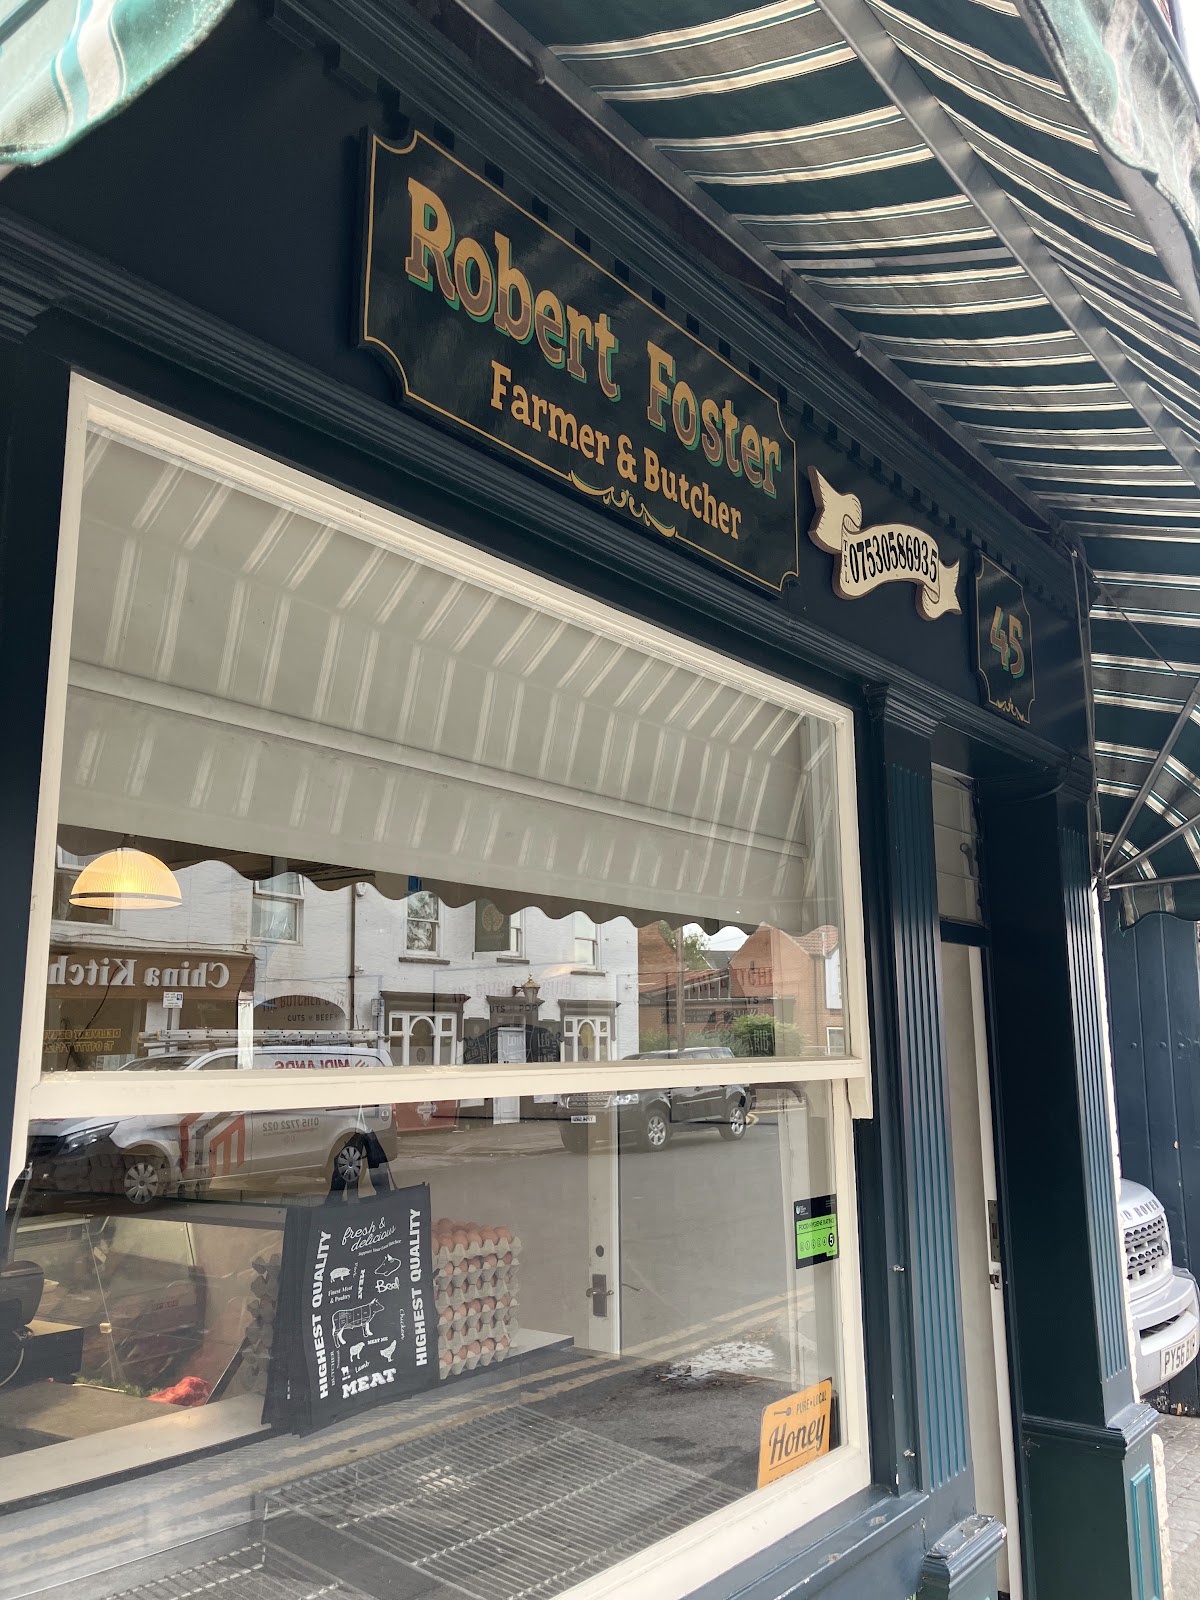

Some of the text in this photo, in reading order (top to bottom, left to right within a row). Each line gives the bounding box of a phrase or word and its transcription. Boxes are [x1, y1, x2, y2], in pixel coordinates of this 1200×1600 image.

[404, 177, 782, 499] Robert Foster
[490, 360, 742, 540] Farmer & Butcher
[850, 531, 939, 584] 07530586935
[989, 605, 1026, 679] 45
[287, 1014, 305, 1022] CUTS
[316, 1013, 334, 1021] BEEF
[490, 1004, 506, 1013] UTS
[518, 1003, 538, 1013] POR
[1133, 1199, 1160, 1217] ROVER
[341, 1217, 386, 1246] fresh &
[351, 1225, 397, 1252] delicious
[375, 1277, 400, 1293] Beef
[410, 1208, 428, 1366] HIGHEST QUALITY
[311, 1231, 332, 1399] HIGHEST QUALITY
[355, 1360, 370, 1374] Lamb
[1164, 1343, 1185, 1375] PY56
[341, 1368, 397, 1399] MEAT
[796, 1390, 827, 1416] PURE LOCAL
[768, 1414, 826, 1466] Honey
